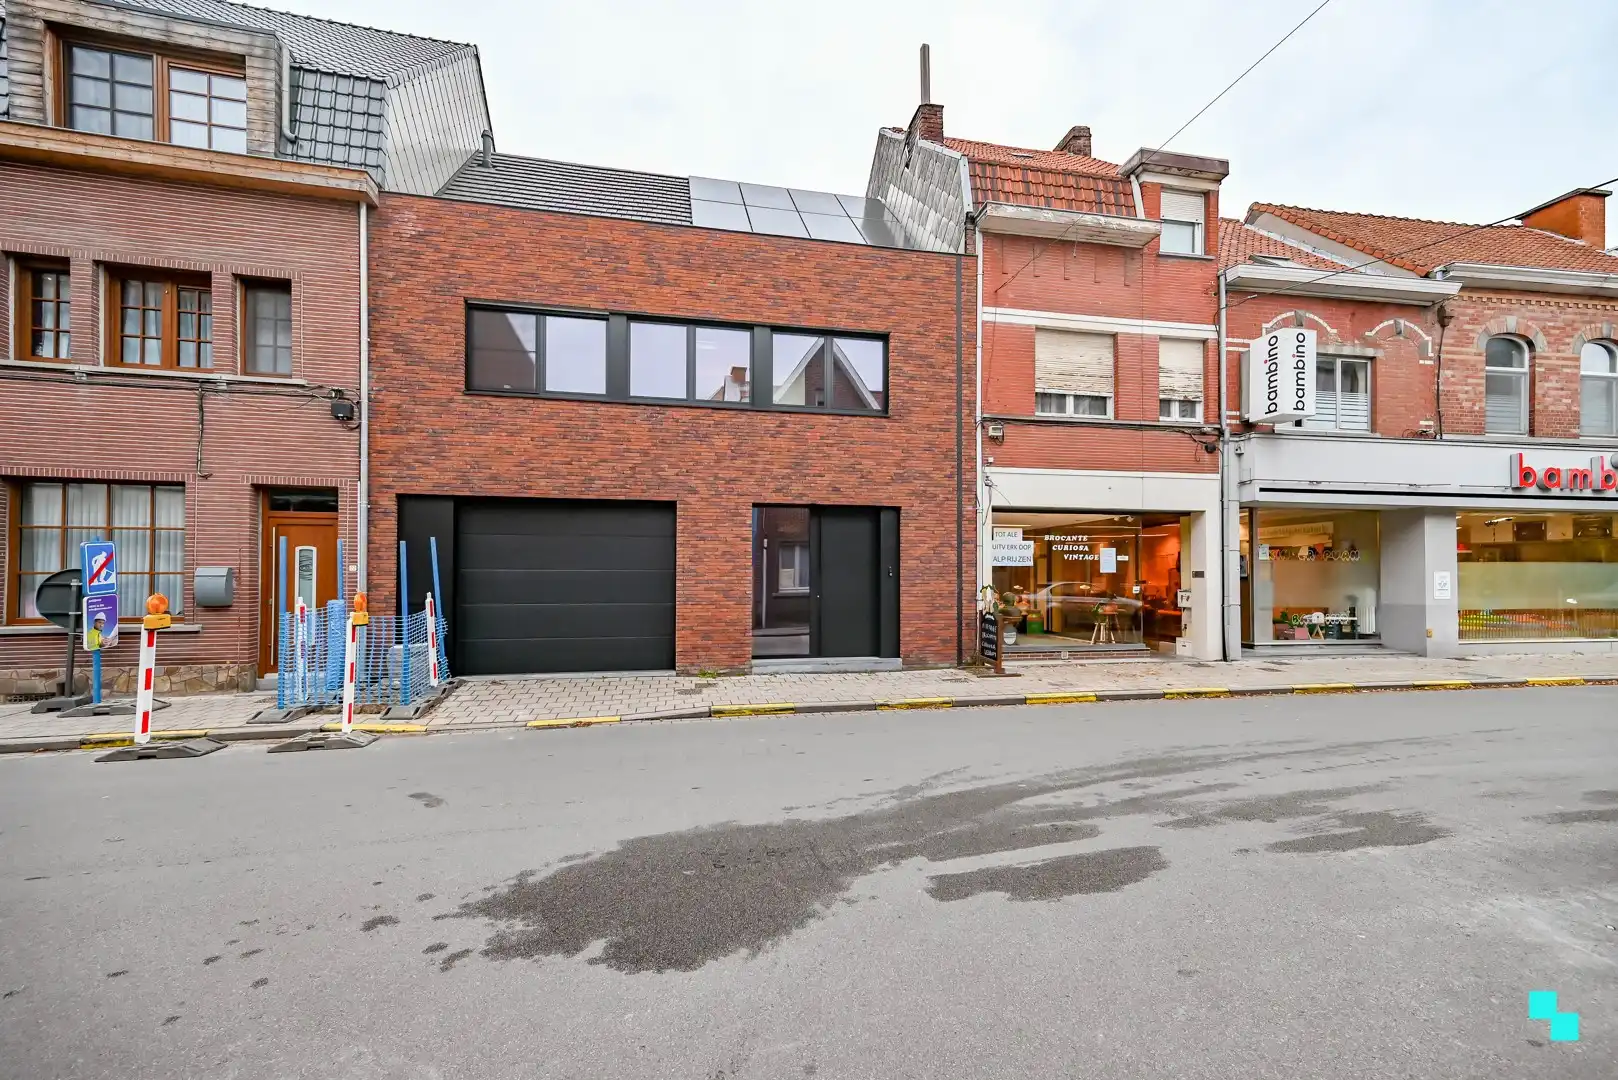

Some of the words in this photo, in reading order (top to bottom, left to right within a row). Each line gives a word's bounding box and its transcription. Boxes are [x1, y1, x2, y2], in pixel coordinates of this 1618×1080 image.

[1264, 335, 1279, 415] bambino
[1292, 332, 1306, 411] bambino
[1513, 452, 1618, 490] bamb
[1044, 534, 1089, 542] BROCANTE
[1052, 544, 1090, 552] CURIOSA
[1063, 553, 1100, 561] VINTAGE
